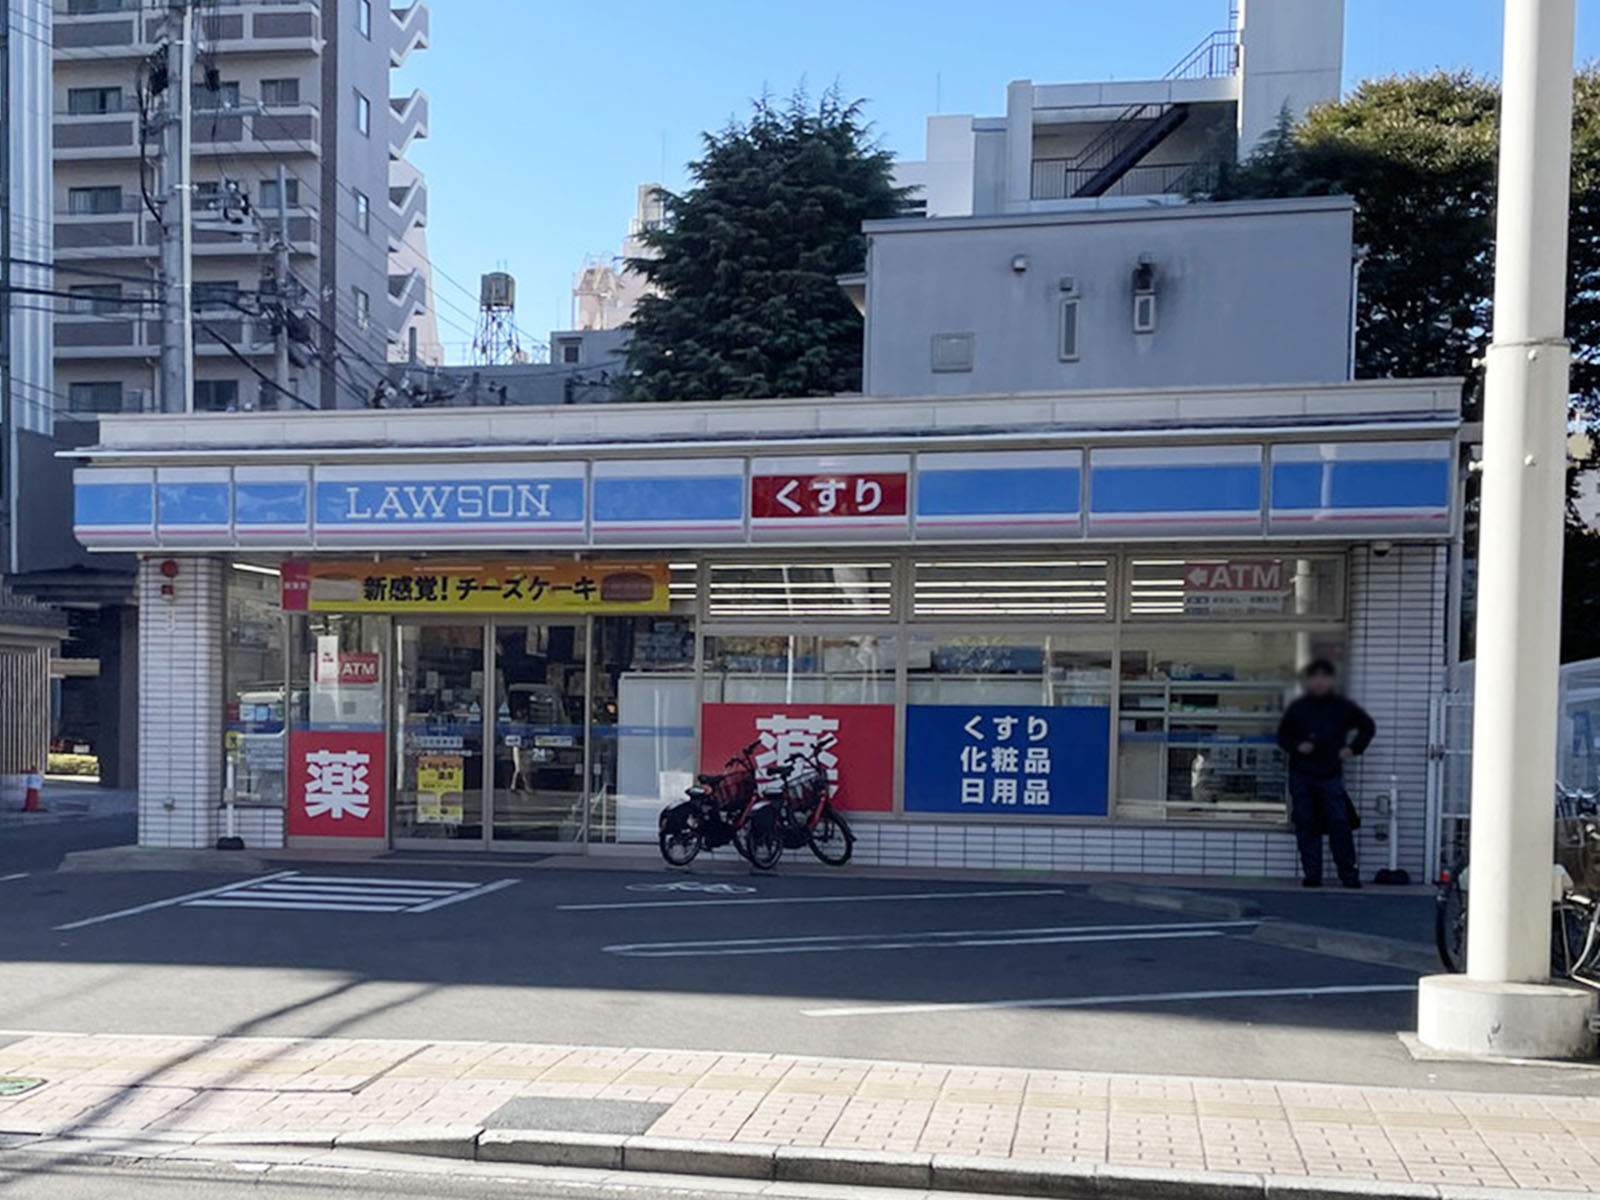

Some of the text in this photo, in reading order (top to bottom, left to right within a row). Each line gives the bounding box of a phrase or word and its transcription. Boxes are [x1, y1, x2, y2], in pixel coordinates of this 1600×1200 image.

[347, 483, 551, 520] LAWSON
[775, 479, 883, 513] くすり
[1210, 565, 1280, 588] ATM
[342, 662, 376, 676] ATM
[964, 715, 1049, 741] くすり
[960, 746, 1051, 772] 化粧品
[304, 749, 370, 819] 薬
[961, 777, 1051, 805] 日用品
